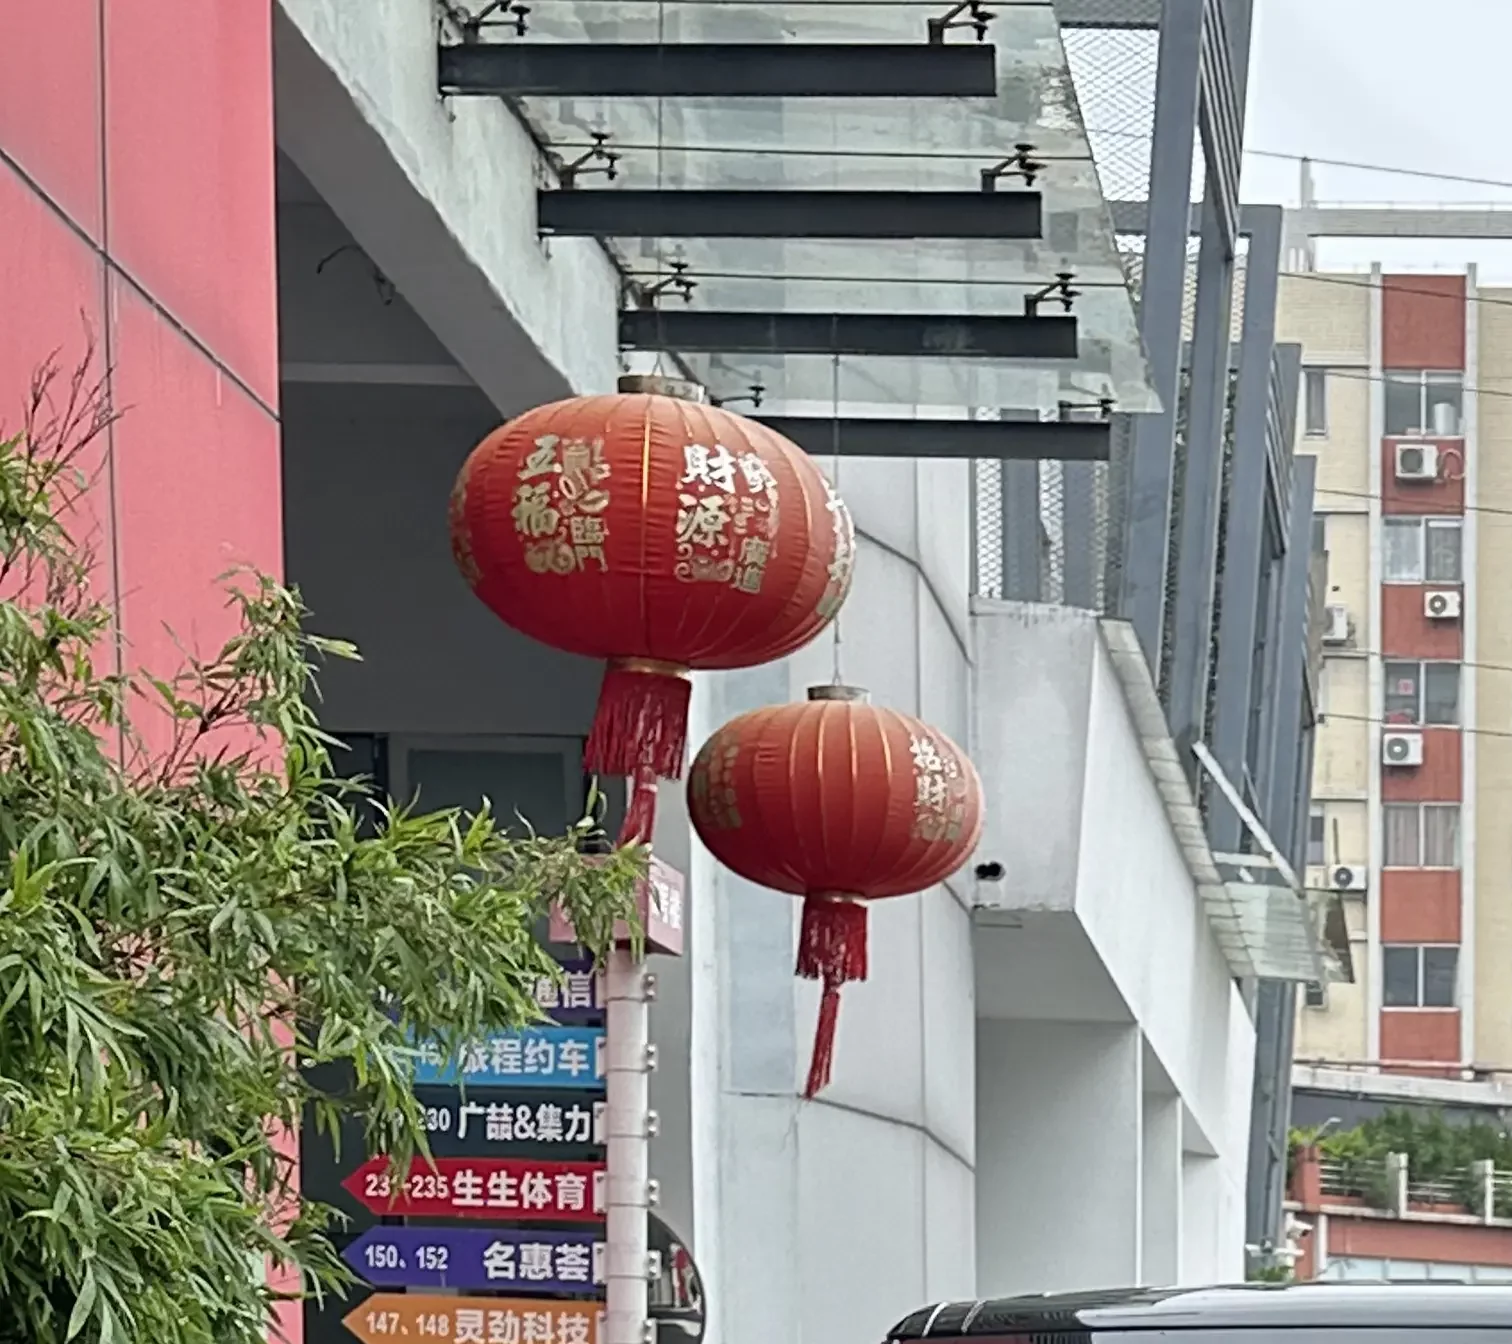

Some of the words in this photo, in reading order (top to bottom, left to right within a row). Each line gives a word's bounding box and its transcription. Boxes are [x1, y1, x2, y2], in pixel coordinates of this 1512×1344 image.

[676, 443, 737, 547] 財源
[451, 1169, 587, 1211] 生生体育
[483, 1241, 590, 1282] 名惠荟
